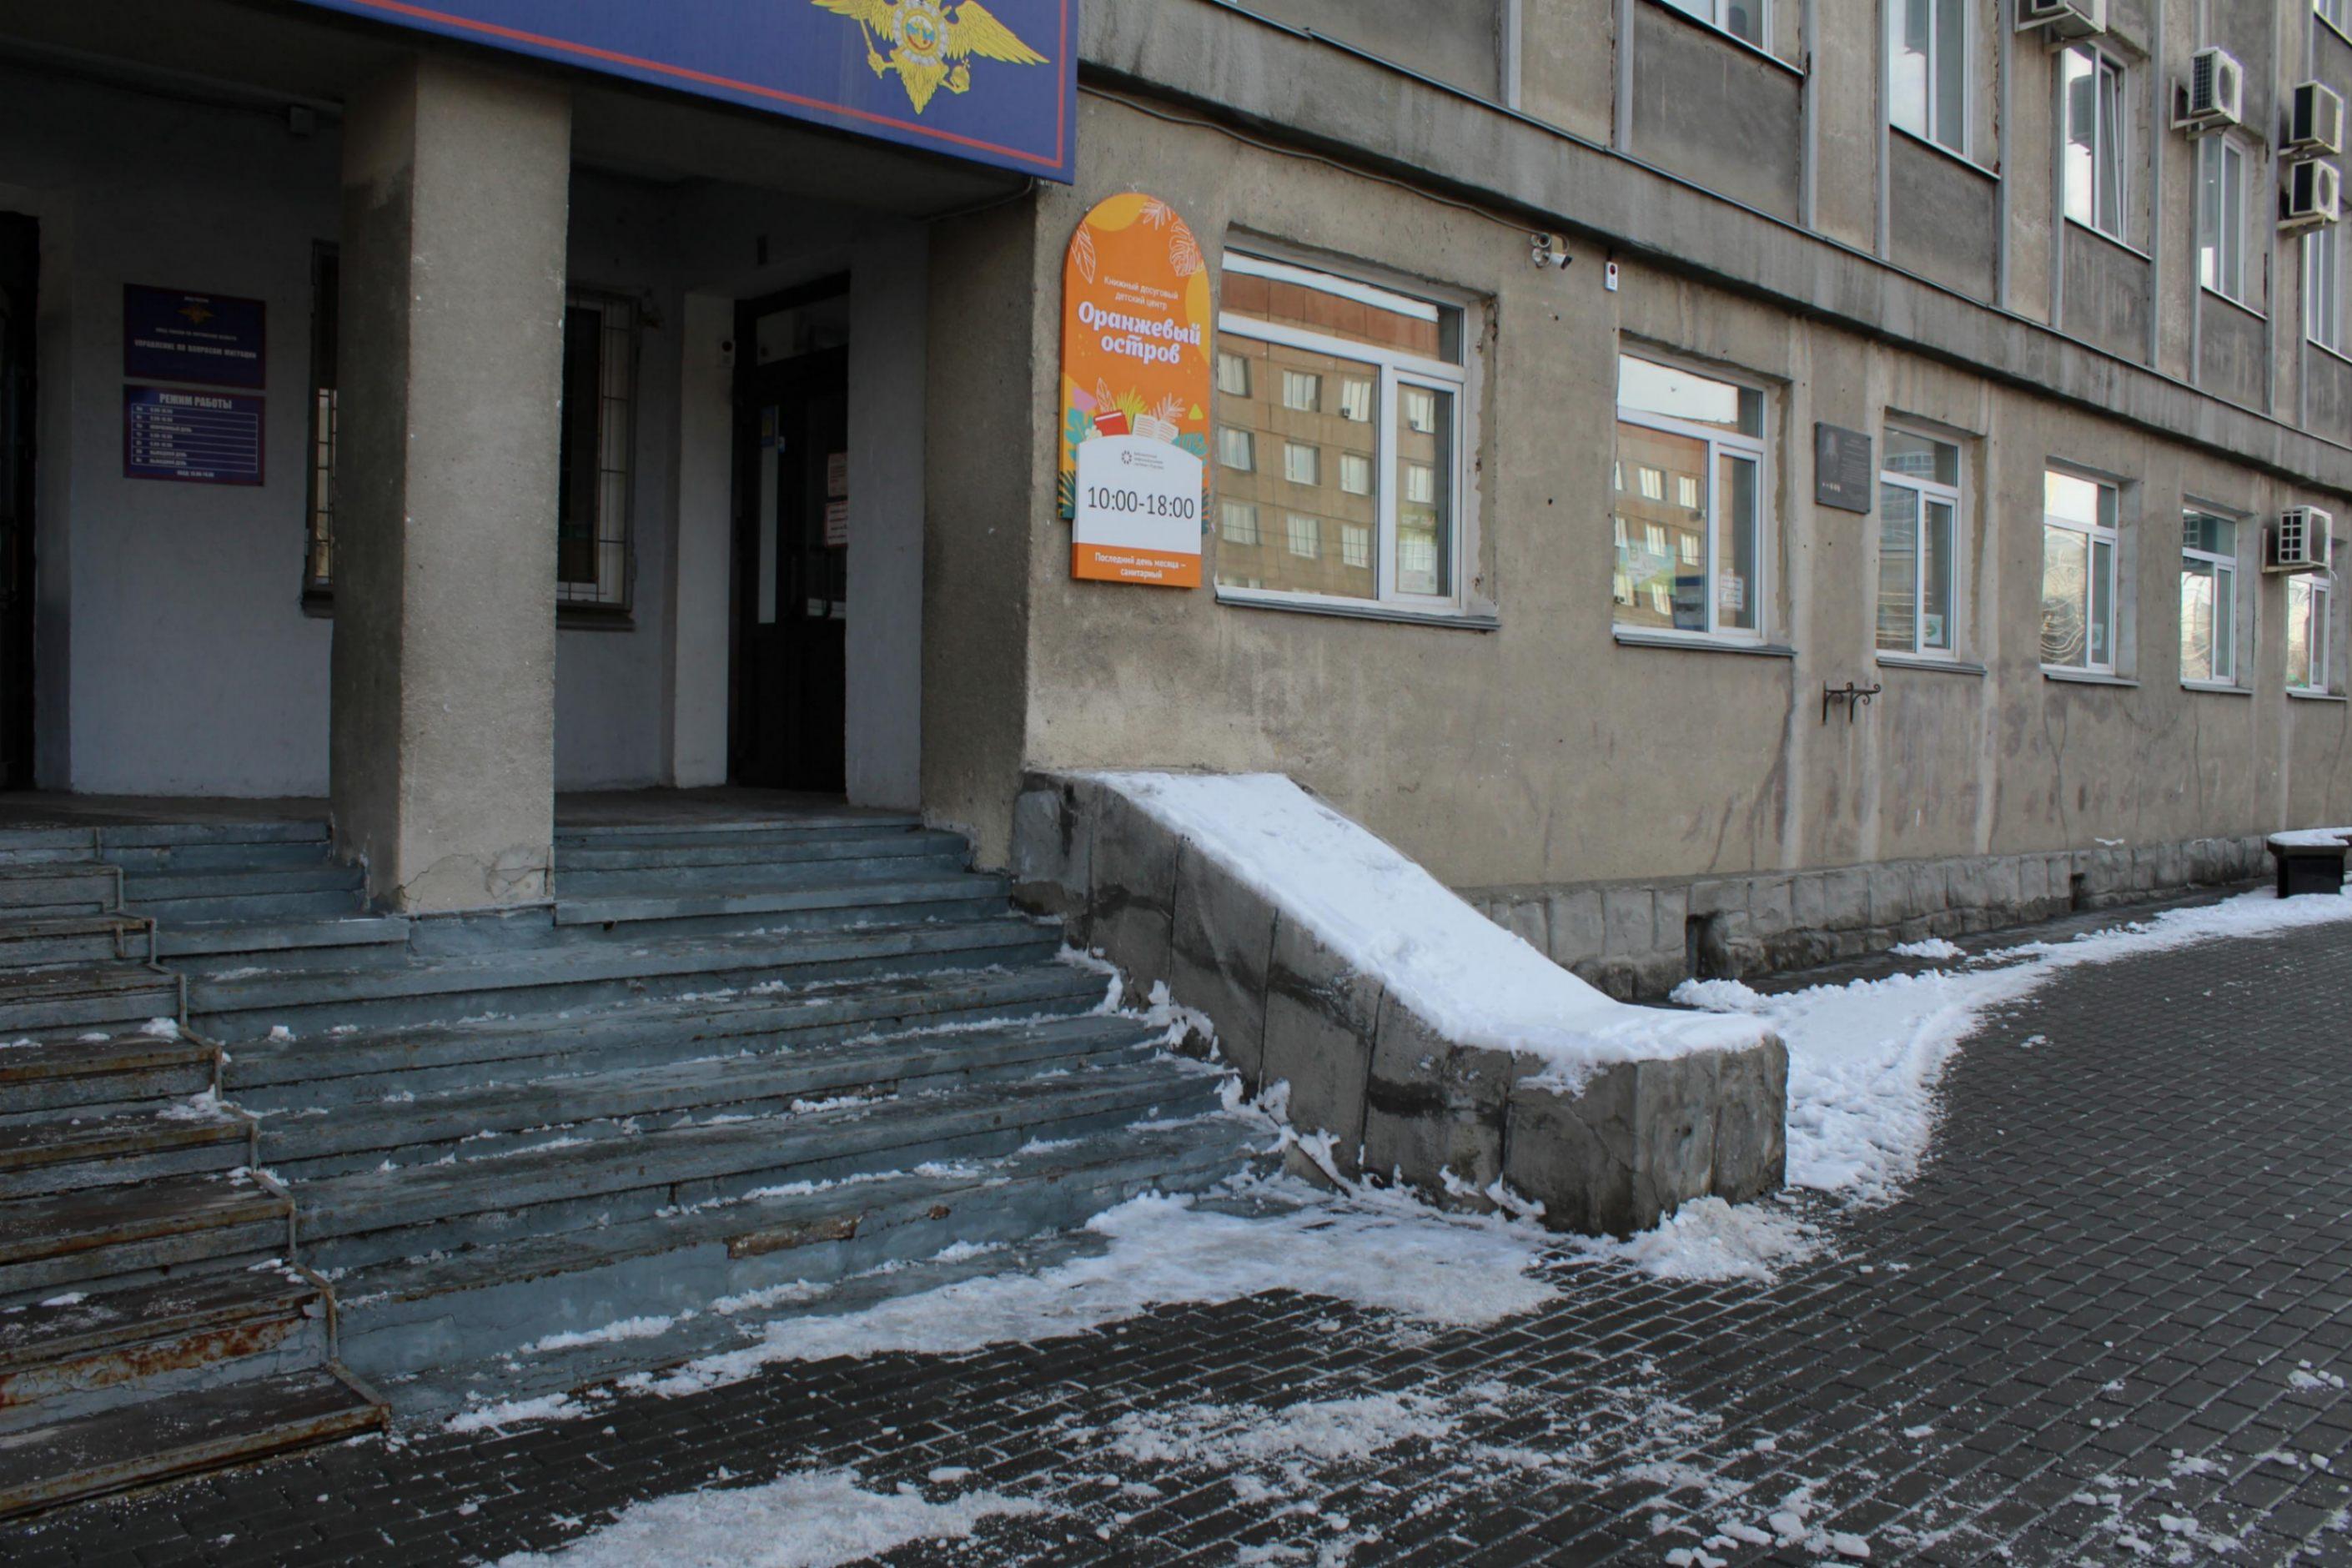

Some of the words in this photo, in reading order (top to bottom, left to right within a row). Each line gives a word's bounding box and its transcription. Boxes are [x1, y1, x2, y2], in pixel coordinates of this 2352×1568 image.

[1103, 275, 1139, 291] Книжный
[1140, 284, 1179, 300] досуговый
[1115, 292, 1146, 305] детский
[1147, 299, 1168, 312] центр
[1078, 301, 1201, 345] Оранжевый
[1101, 334, 1181, 364] остров
[159, 393, 193, 407] РЕЖИМ
[194, 396, 232, 410] РАБОТЫ
[1088, 487, 1194, 519] 10:00-18:00
[1095, 551, 1135, 565] Последний
[1135, 557, 1153, 567] день
[1154, 560, 1179, 570] месяца
[1120, 567, 1163, 580] санитарный
